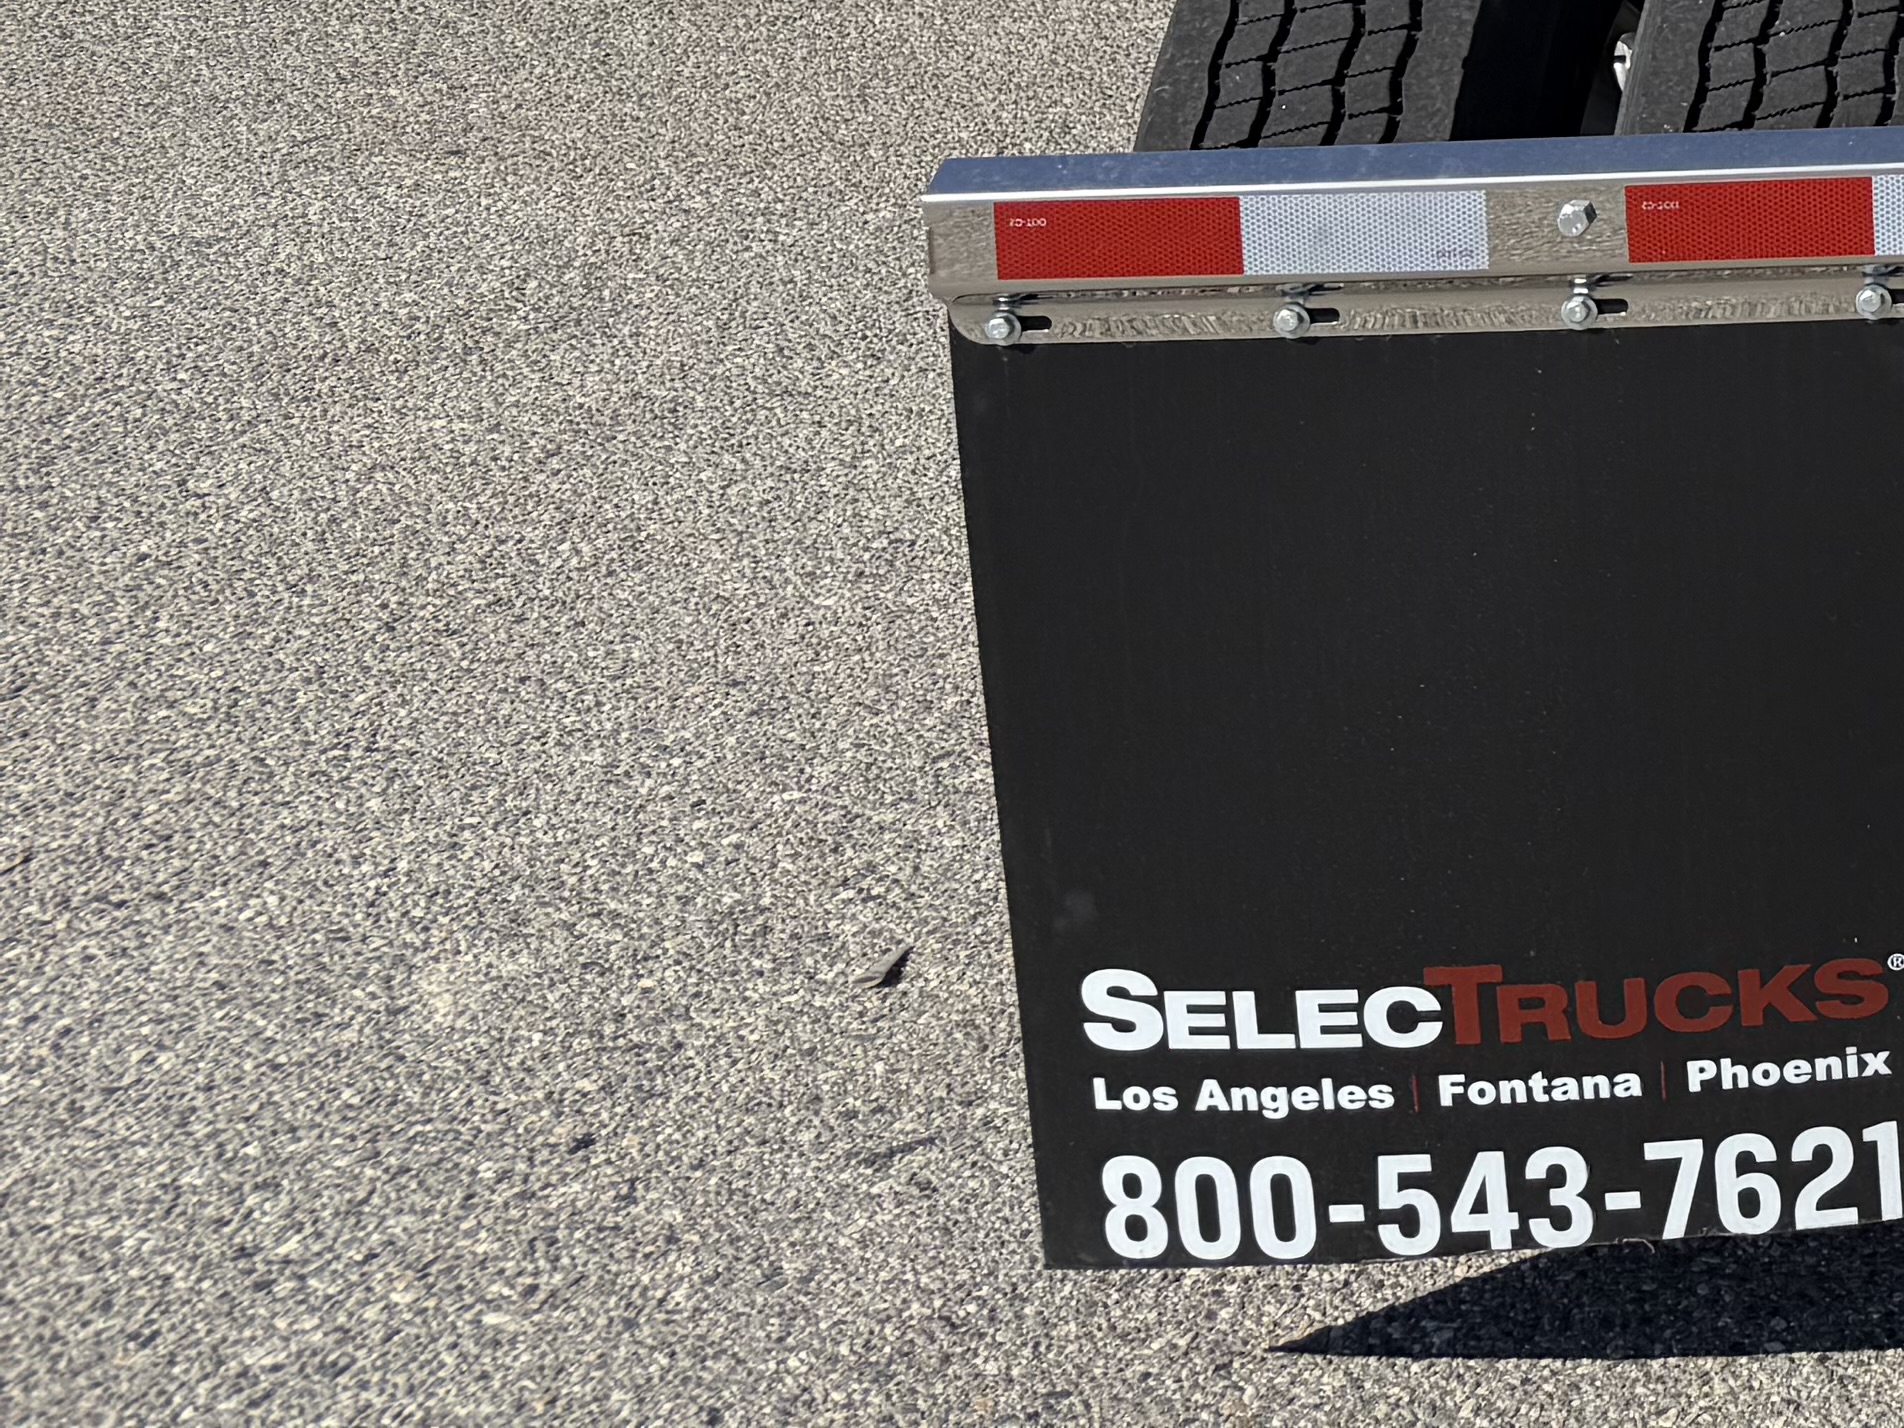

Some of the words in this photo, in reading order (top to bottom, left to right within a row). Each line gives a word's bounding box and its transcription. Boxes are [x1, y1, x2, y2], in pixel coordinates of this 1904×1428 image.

[1092, 1076, 1179, 1112] Los
[1194, 1076, 1395, 1120] Angeles
[1438, 1070, 1643, 1107] Fontana
[1686, 1046, 1892, 1093] Phoenix
[1101, 1120, 1904, 1260] 800-543-7621
